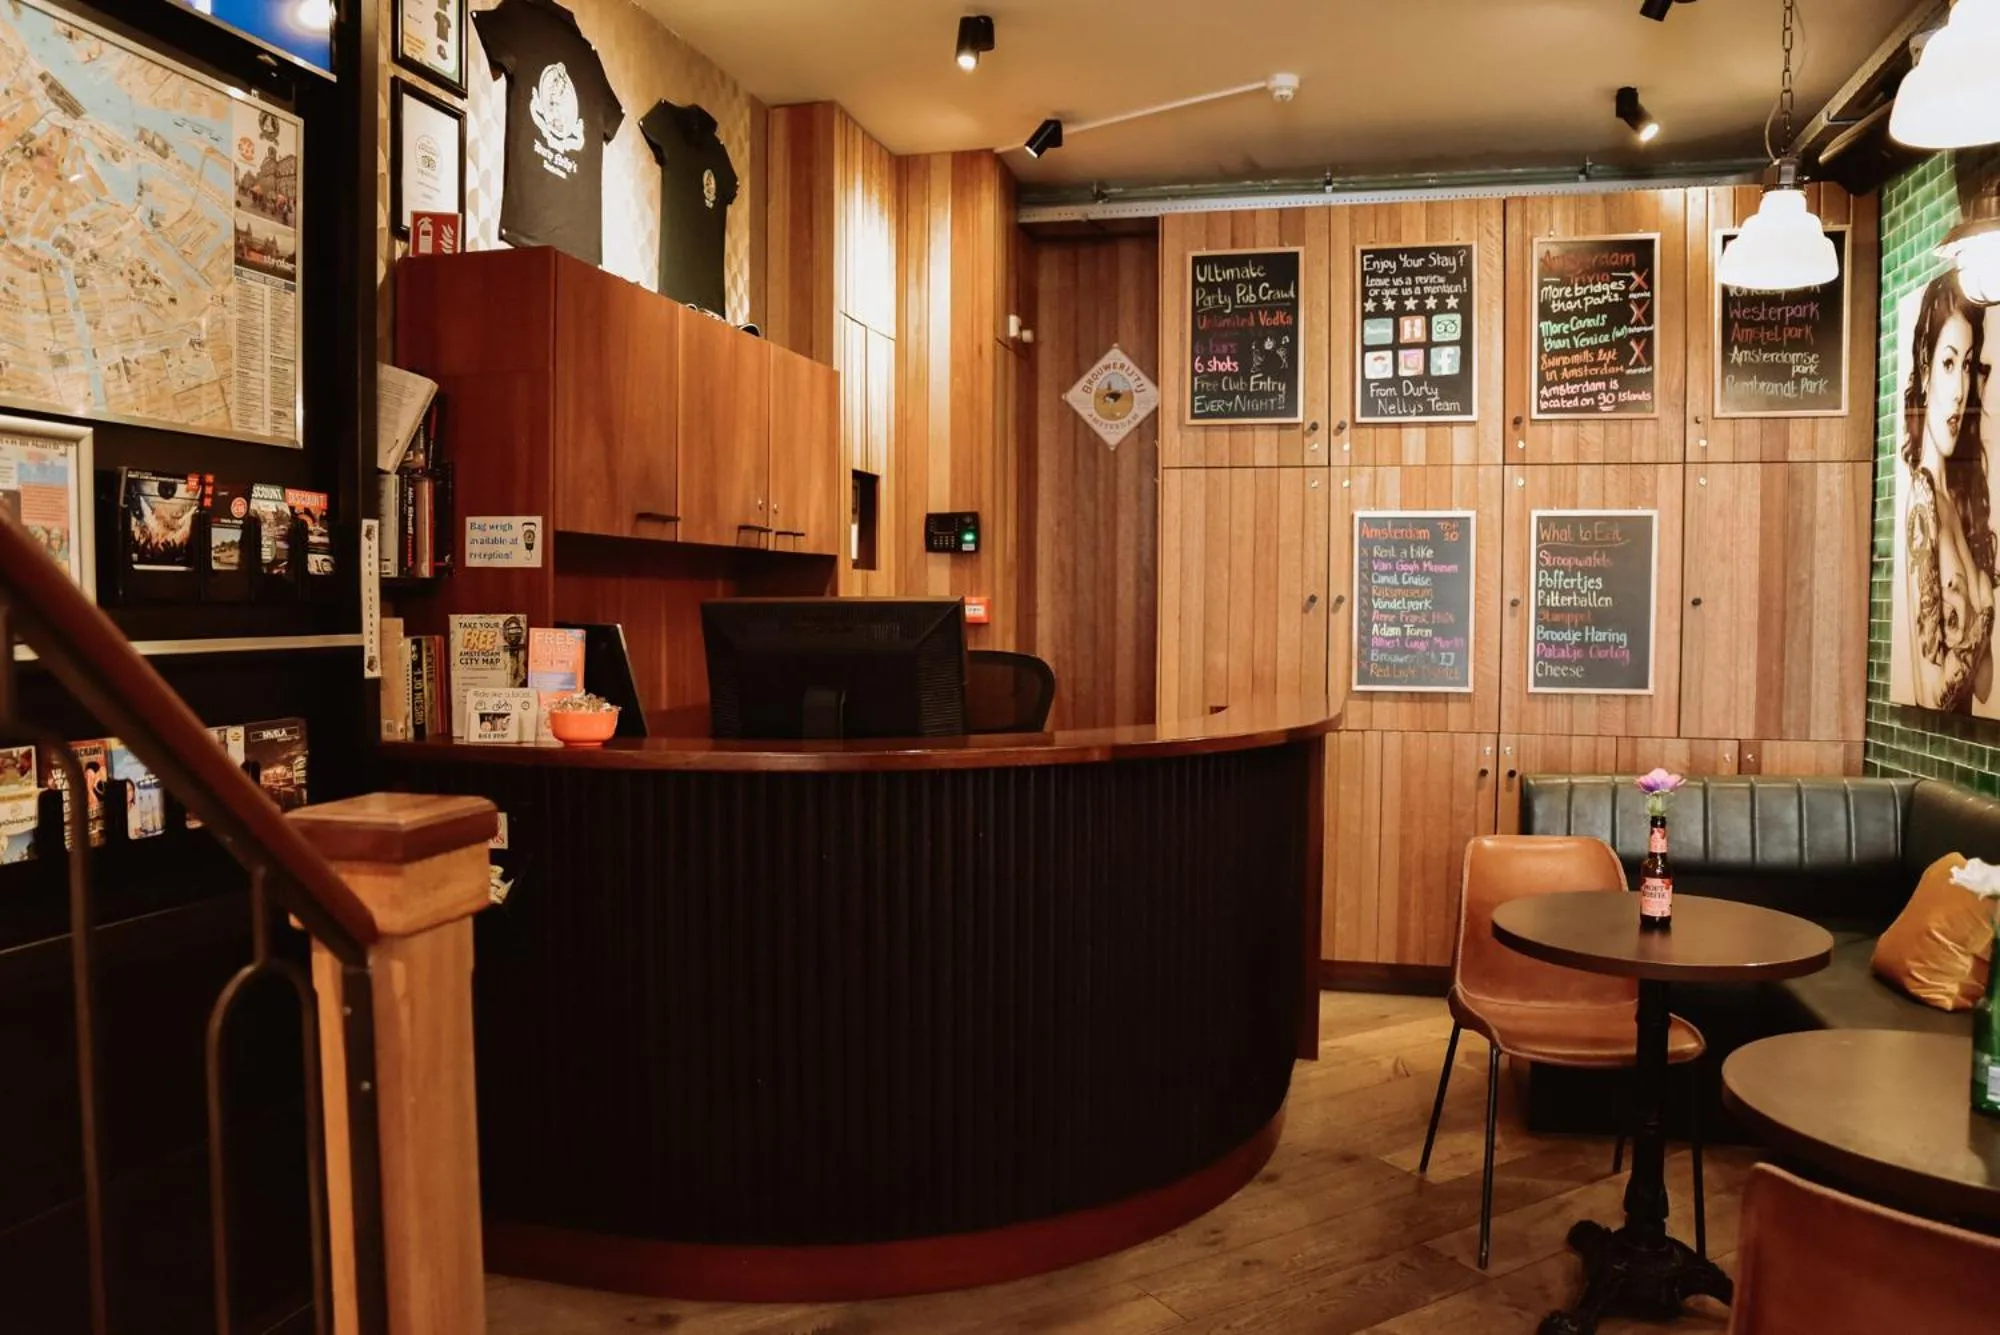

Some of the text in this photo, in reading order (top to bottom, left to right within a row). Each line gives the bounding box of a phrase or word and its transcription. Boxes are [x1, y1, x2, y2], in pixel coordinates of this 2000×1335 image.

[1196, 260, 1266, 283] Ultimate
[1363, 254, 1397, 273] Enjoy
[1399, 253, 1425, 268] Your
[1365, 274, 1446, 287] Leave us a review
[1196, 281, 1296, 313] Party Pub Crawl
[1369, 288, 1380, 297] or
[1401, 287, 1413, 296] us
[1414, 287, 1421, 295] a
[1540, 286, 1572, 303] More
[1574, 280, 1625, 299] bridges
[1551, 300, 1582, 313] than
[1728, 300, 1820, 325] Westerpark
[1540, 320, 1570, 337] More
[1544, 337, 1571, 352] than
[1572, 331, 1611, 348] Venice
[1194, 355, 1239, 373] 6 shots
[1560, 364, 1625, 379] Amsterdam
[1792, 364, 1818, 377] park
[1194, 373, 1286, 394] Free Club Entry
[1369, 380, 1439, 398] From Durty
[1540, 378, 1619, 398] Amsterdam is
[1377, 398, 1460, 416] Nelly's Team
[1540, 396, 1579, 410] located
[1580, 397, 1594, 406] on
[1597, 393, 1615, 406] 90
[470, 522, 512, 532] Bag weigh
[1361, 521, 1430, 541] Amsterdam
[1539, 521, 1622, 542] What to Eat
[470, 536, 518, 545] available at
[469, 551, 512, 560] reception!
[1373, 545, 1396, 558] Rent
[1399, 547, 1407, 558] a
[1372, 559, 1392, 571] Van
[1395, 560, 1419, 574] Gogh
[1539, 550, 1613, 572] Stroopwafels
[1372, 572, 1432, 586] Canal Cruise
[1538, 569, 1603, 595] Poffertjes
[1372, 597, 1432, 612] Vondelpark
[1537, 590, 1613, 608] Bitterballen
[463, 630, 497, 651] FREE
[534, 632, 575, 644] FREE
[1536, 625, 1628, 648] Broodje Haring
[459, 657, 501, 665] CITY MAP
[1536, 661, 1584, 677] Cheese
